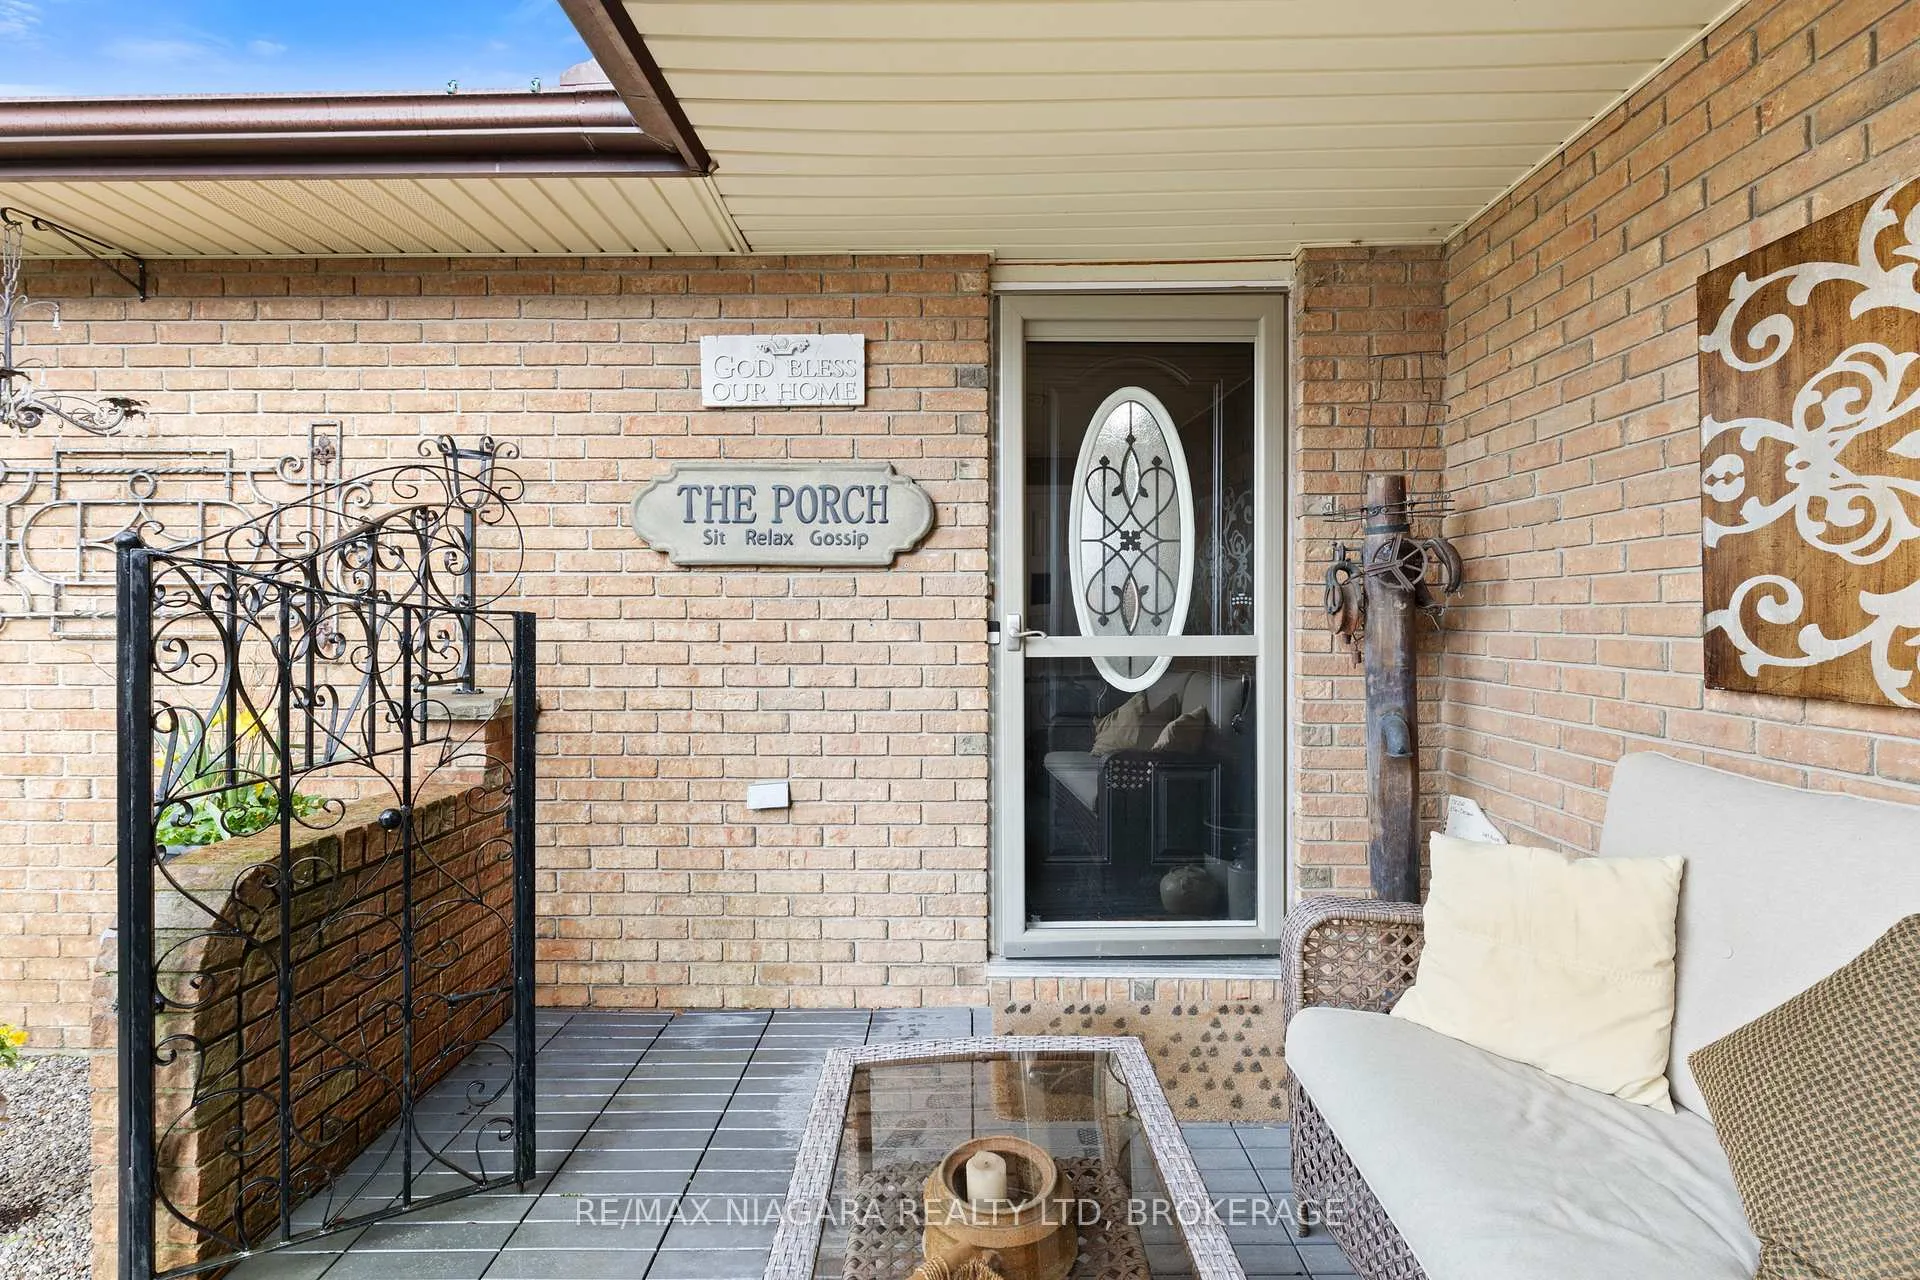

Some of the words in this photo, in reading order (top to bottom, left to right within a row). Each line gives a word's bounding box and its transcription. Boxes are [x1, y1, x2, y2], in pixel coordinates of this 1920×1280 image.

[714, 354, 775, 379] GOD
[787, 358, 857, 378] BLESS
[712, 382, 768, 402] OUR
[777, 382, 857, 401] HOME
[677, 484, 757, 524] THE
[771, 484, 889, 524] PORCH
[703, 528, 726, 546] Sit
[745, 528, 794, 546] Relax
[809, 529, 869, 549] Gossip
